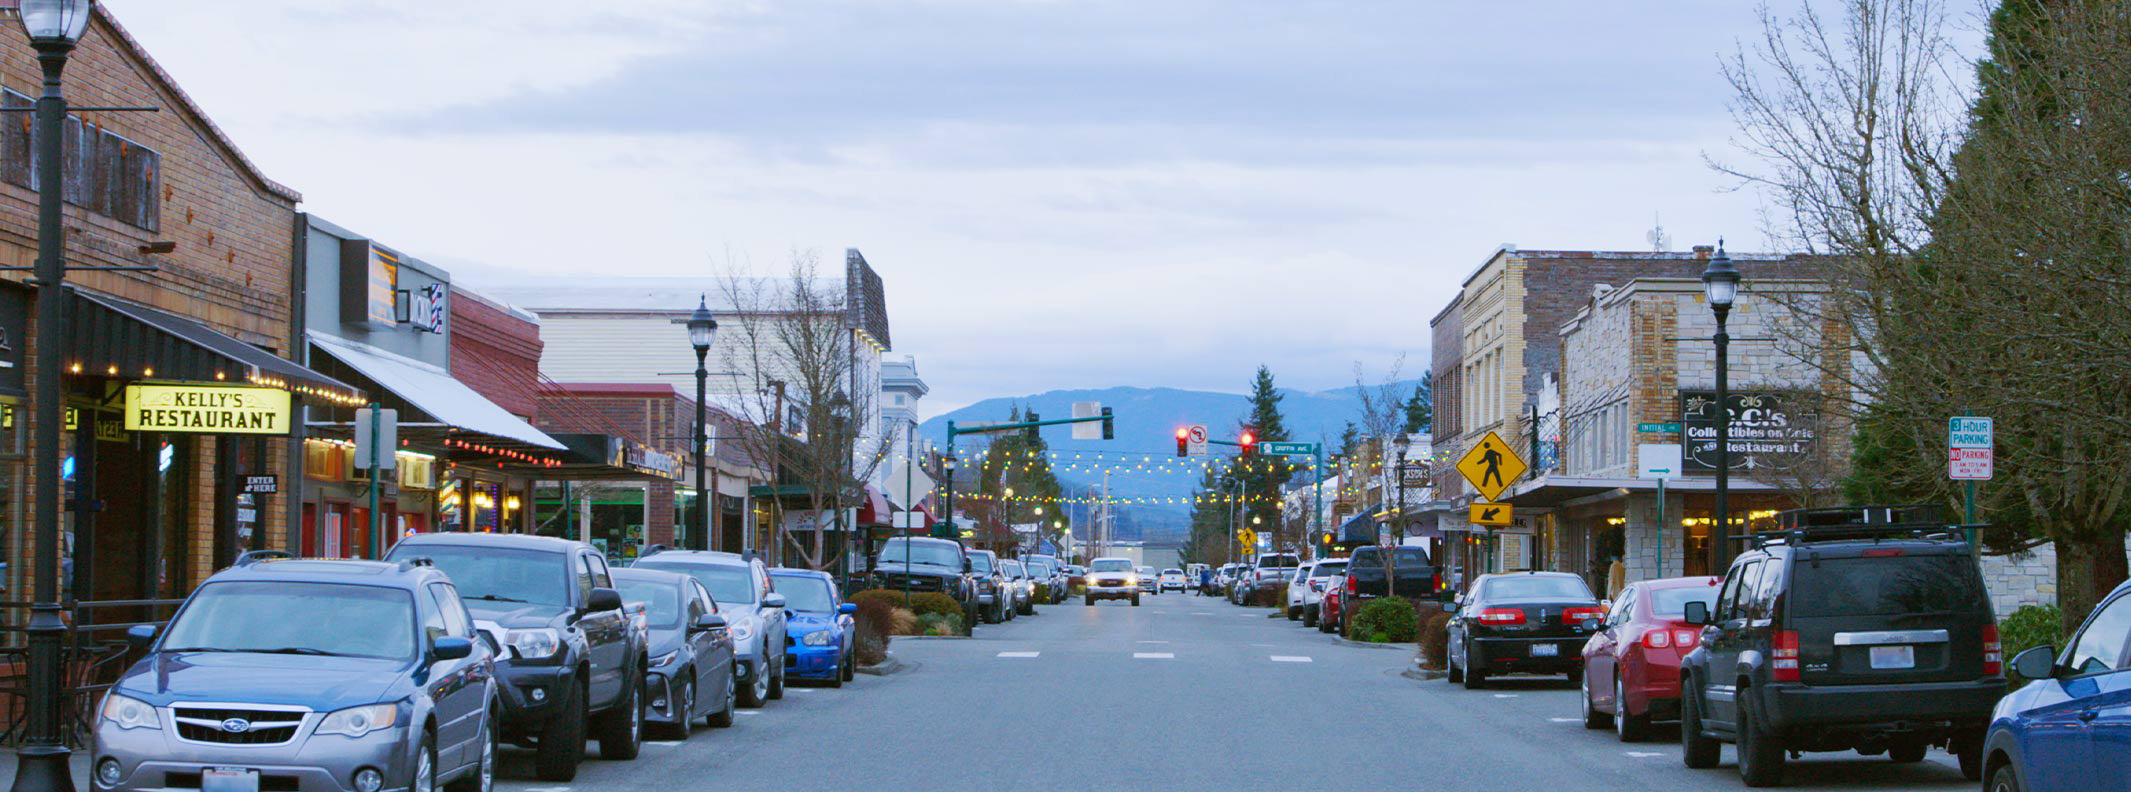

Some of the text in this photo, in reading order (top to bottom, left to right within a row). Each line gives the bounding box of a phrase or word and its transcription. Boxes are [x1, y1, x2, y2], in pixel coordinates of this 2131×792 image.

[174, 391, 243, 408] KELLY'S
[139, 409, 276, 429] RESTAURANT
[1641, 423, 1667, 432] INITIAL
[1953, 420, 1988, 433] 3 HOUR
[1767, 429, 1784, 439] on
[1953, 433, 1989, 445] PARKING
[1951, 449, 1989, 459] NO PARKING
[247, 476, 274, 484] ENTER
[253, 484, 277, 493] HERE
